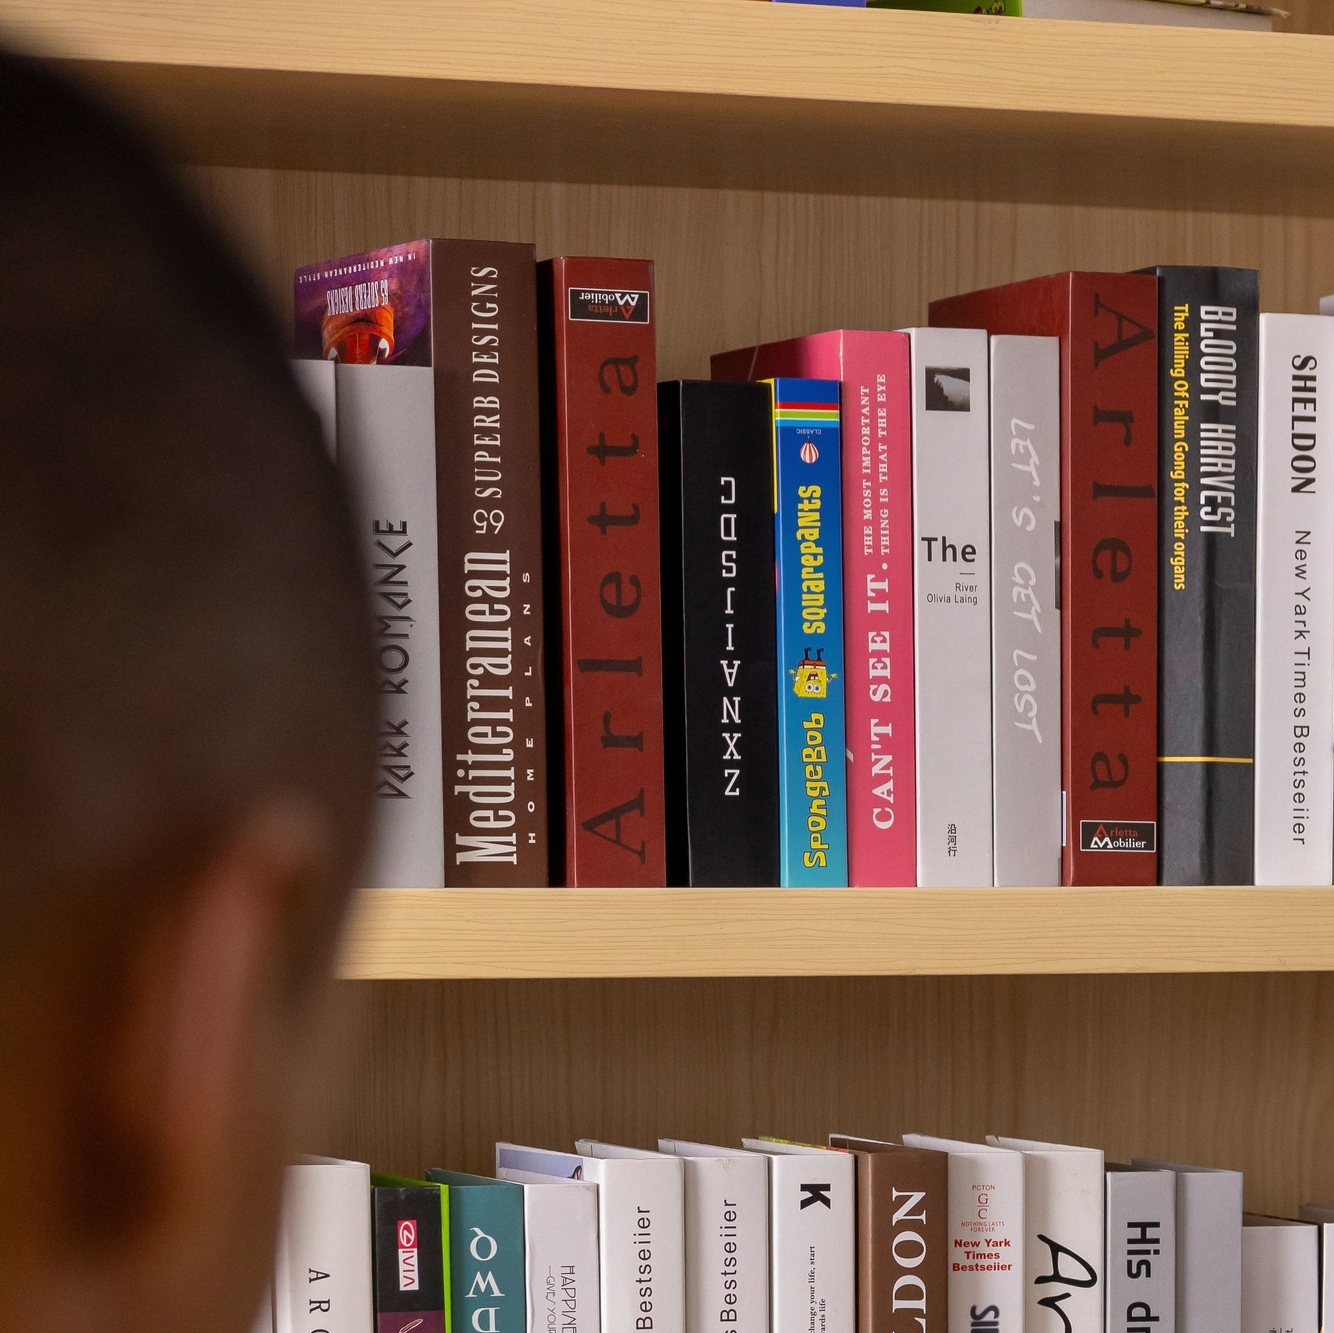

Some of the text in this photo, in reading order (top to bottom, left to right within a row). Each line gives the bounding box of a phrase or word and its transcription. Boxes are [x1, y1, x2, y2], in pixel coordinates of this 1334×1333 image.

[579, 293, 639, 306] Mobilier
[588, 304, 634, 320] Arletta
[795, 427, 823, 436] CLASSIC
[1200, 306, 1236, 537] BLOODY HARVEST
[1291, 355, 1317, 493] SHELDON
[860, 385, 874, 556] THE MOST IMPORTANT
[876, 373, 890, 556] THING IS THAT THE EYE
[1170, 304, 1189, 590] The killing Of Falun Gong for their organs
[455, 267, 517, 865] Mediterranean 65 SUPERB DESIGNS
[921, 536, 976, 562] The
[1092, 293, 1156, 790] Arletta
[1295, 531, 1311, 580] New
[577, 354, 645, 864] Arletta
[926, 593, 978, 606] Olivia Laing
[955, 582, 978, 593] River
[1012, 562, 1041, 633] GET
[1295, 587, 1310, 640] Yark
[867, 563, 894, 829] CAN'T SEE IT.
[1013, 649, 1042, 743] LOST
[1294, 647, 1310, 717] Times
[522, 572, 536, 844] HOME PLANS
[947, 823, 958, 858] 沿河行
[1089, 836, 1147, 849] Mobilier
[1094, 823, 1138, 838] Arletta
[800, 1184, 830, 1210] K
[951, 1260, 1014, 1273] Bestseiier
[953, 1237, 1012, 1249] New Yark
[963, 1250, 1001, 1261] Times
[1127, 1222, 1160, 1279] His
[807, 1269, 816, 1284] life,
[809, 1285, 818, 1305] your
